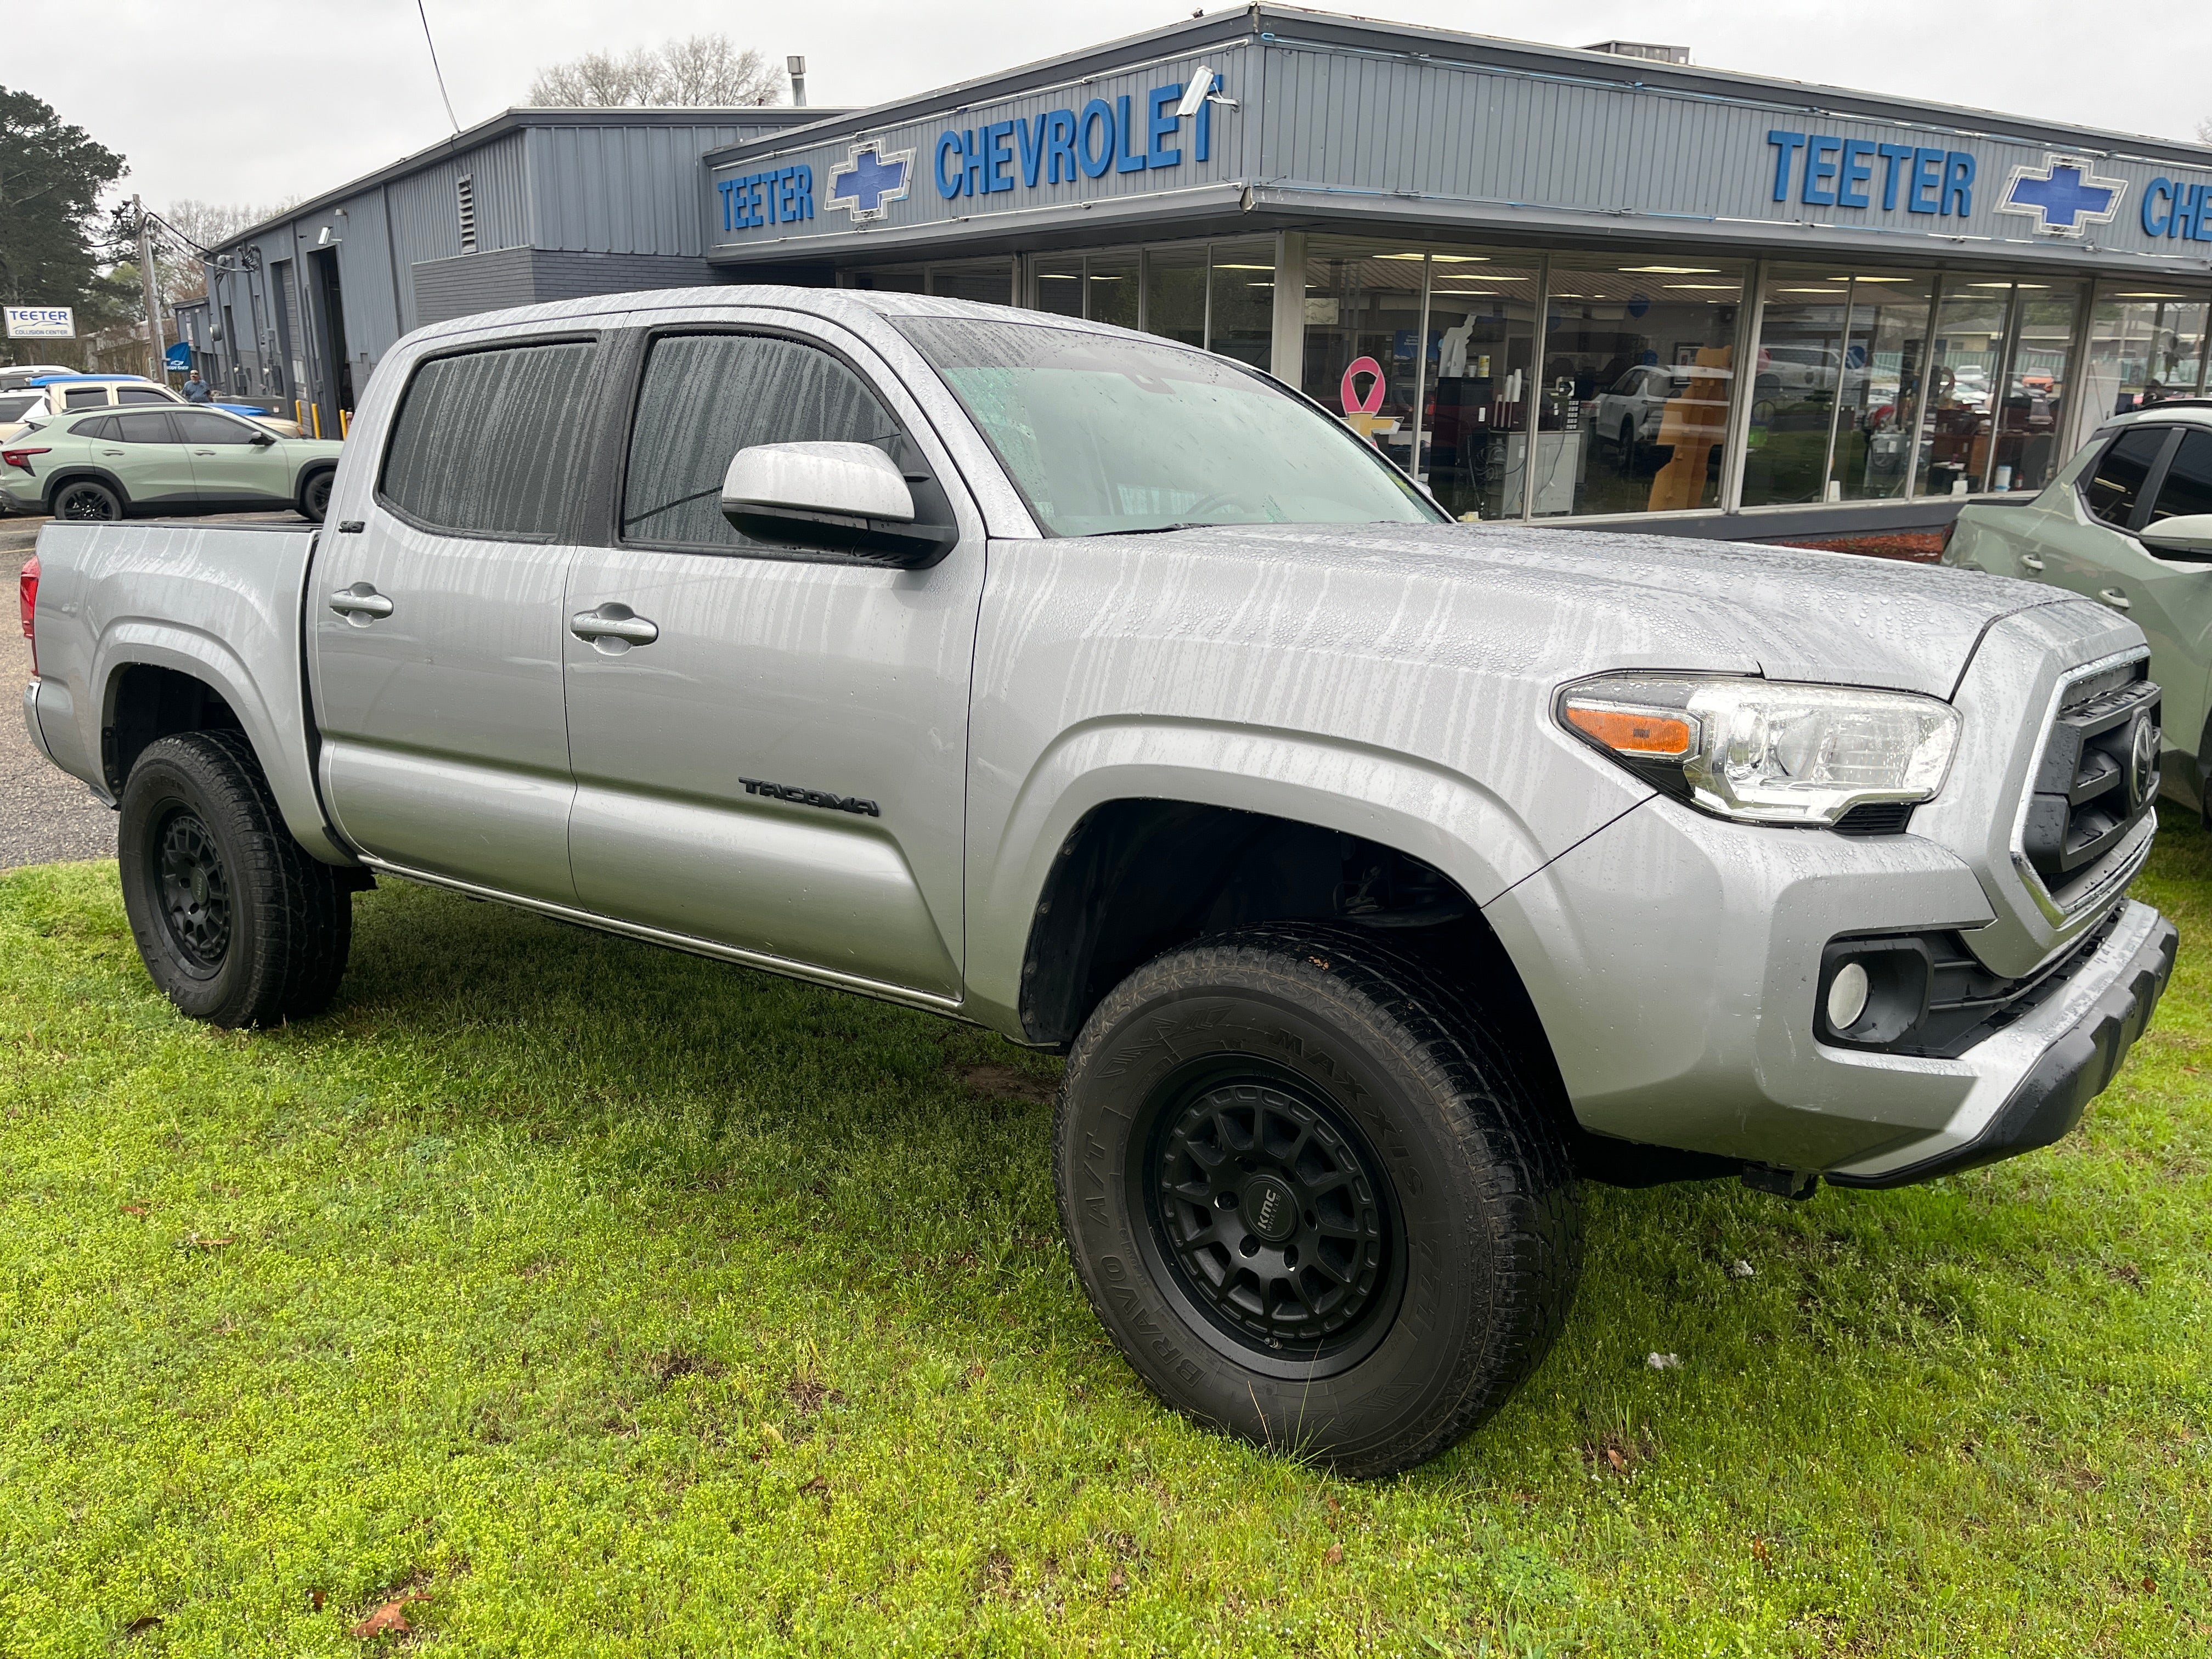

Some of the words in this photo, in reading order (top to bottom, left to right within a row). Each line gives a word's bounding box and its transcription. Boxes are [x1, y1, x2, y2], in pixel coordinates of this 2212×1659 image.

[718, 164, 814, 231] TEETER
[934, 74, 1224, 200] CHEVROLET
[1768, 129, 1975, 217] TEETER
[2142, 177, 2212, 241] CHE
[9, 311, 68, 320] TEETER
[738, 776, 879, 817] TACOMA
[1272, 1028, 1425, 1199] MAXXIS
[1266, 1194, 1281, 1231] WHEELS
[1101, 1255, 1206, 1387] BRAVO
